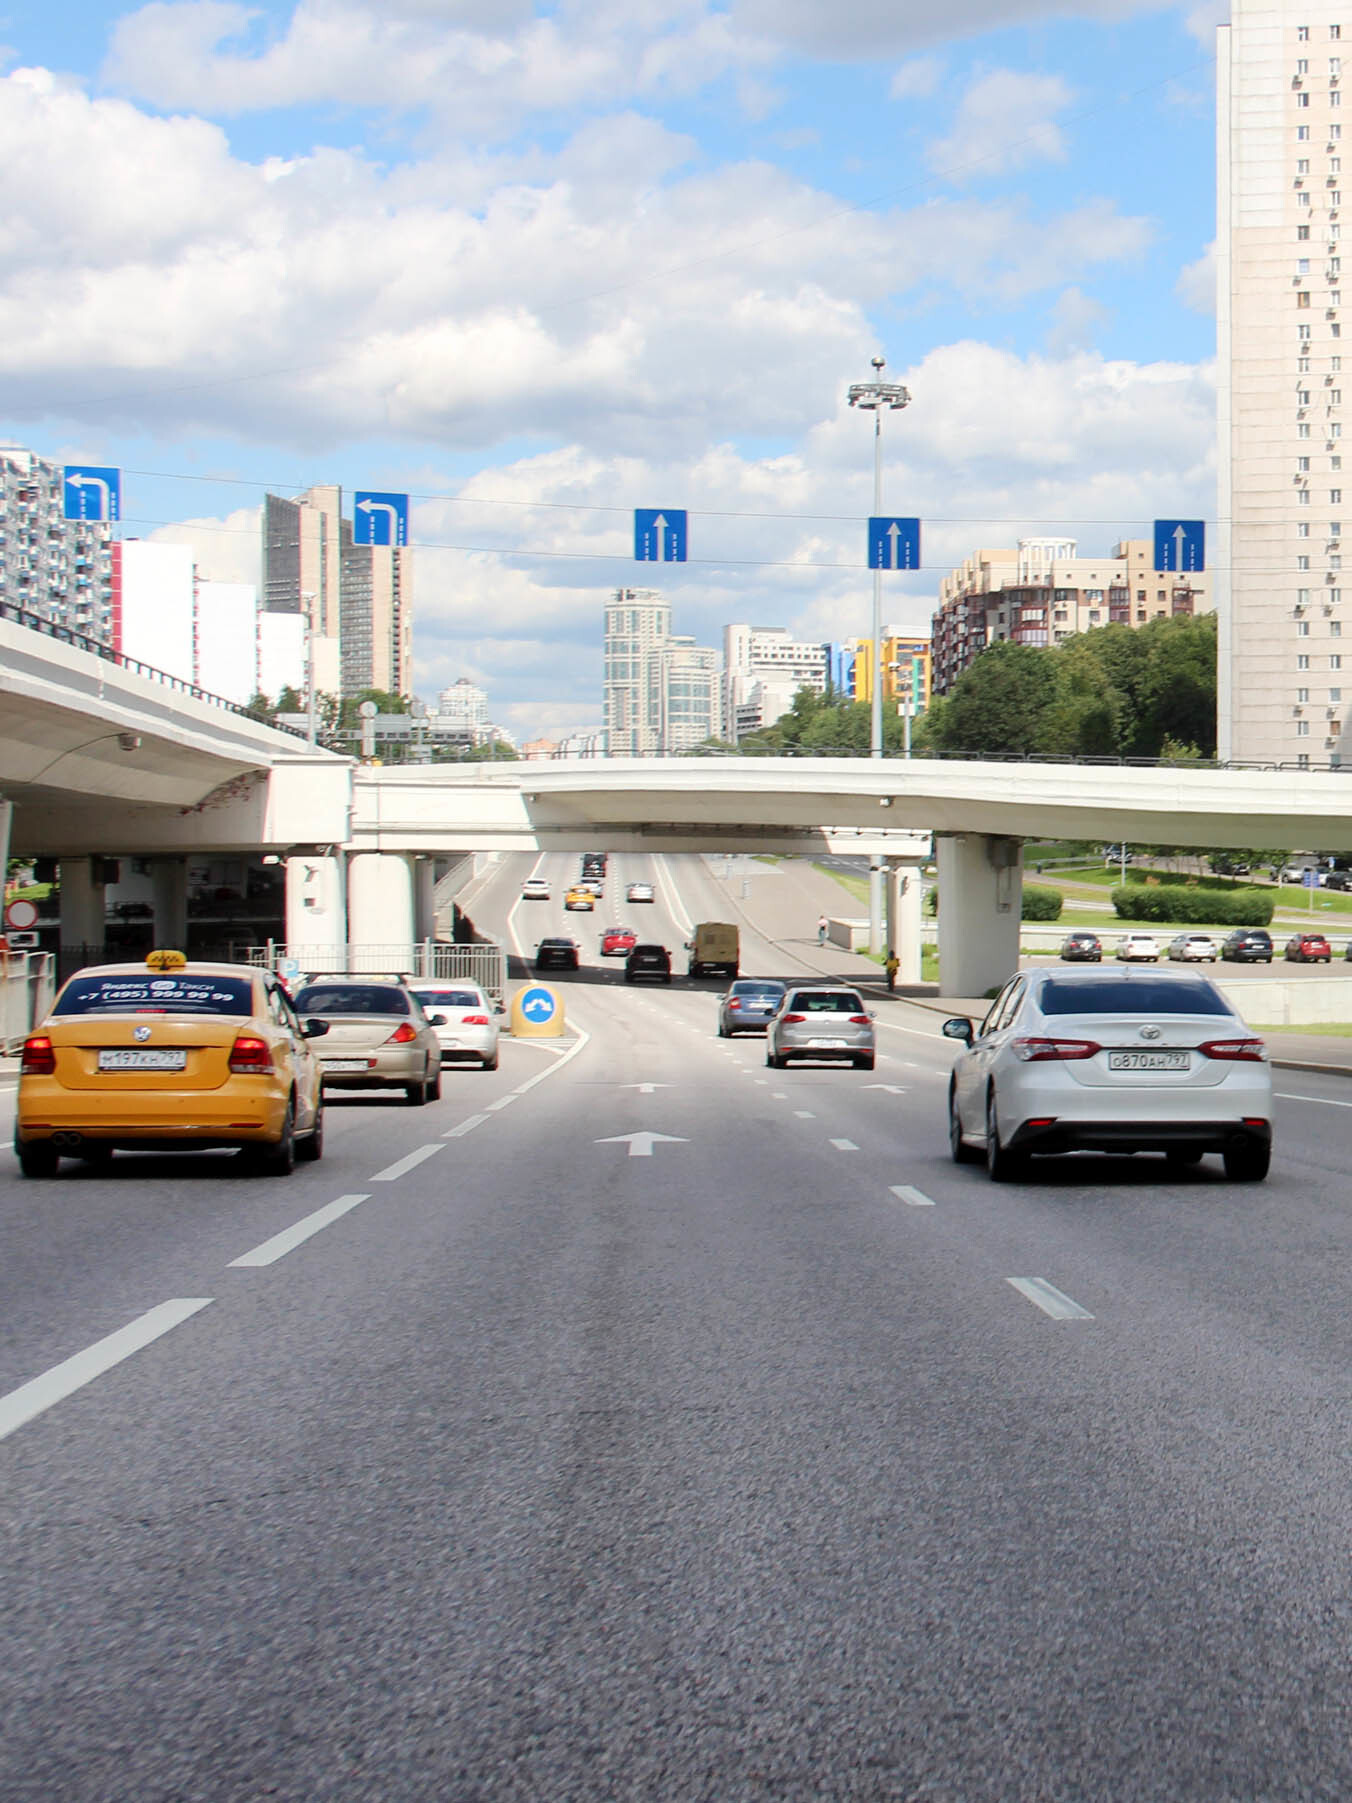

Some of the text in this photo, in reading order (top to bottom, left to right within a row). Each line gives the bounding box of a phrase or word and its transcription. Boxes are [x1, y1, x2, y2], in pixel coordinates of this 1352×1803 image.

[179, 982, 215, 991] Такси
[78, 991, 234, 1001] +7 (495) 999 99 99
